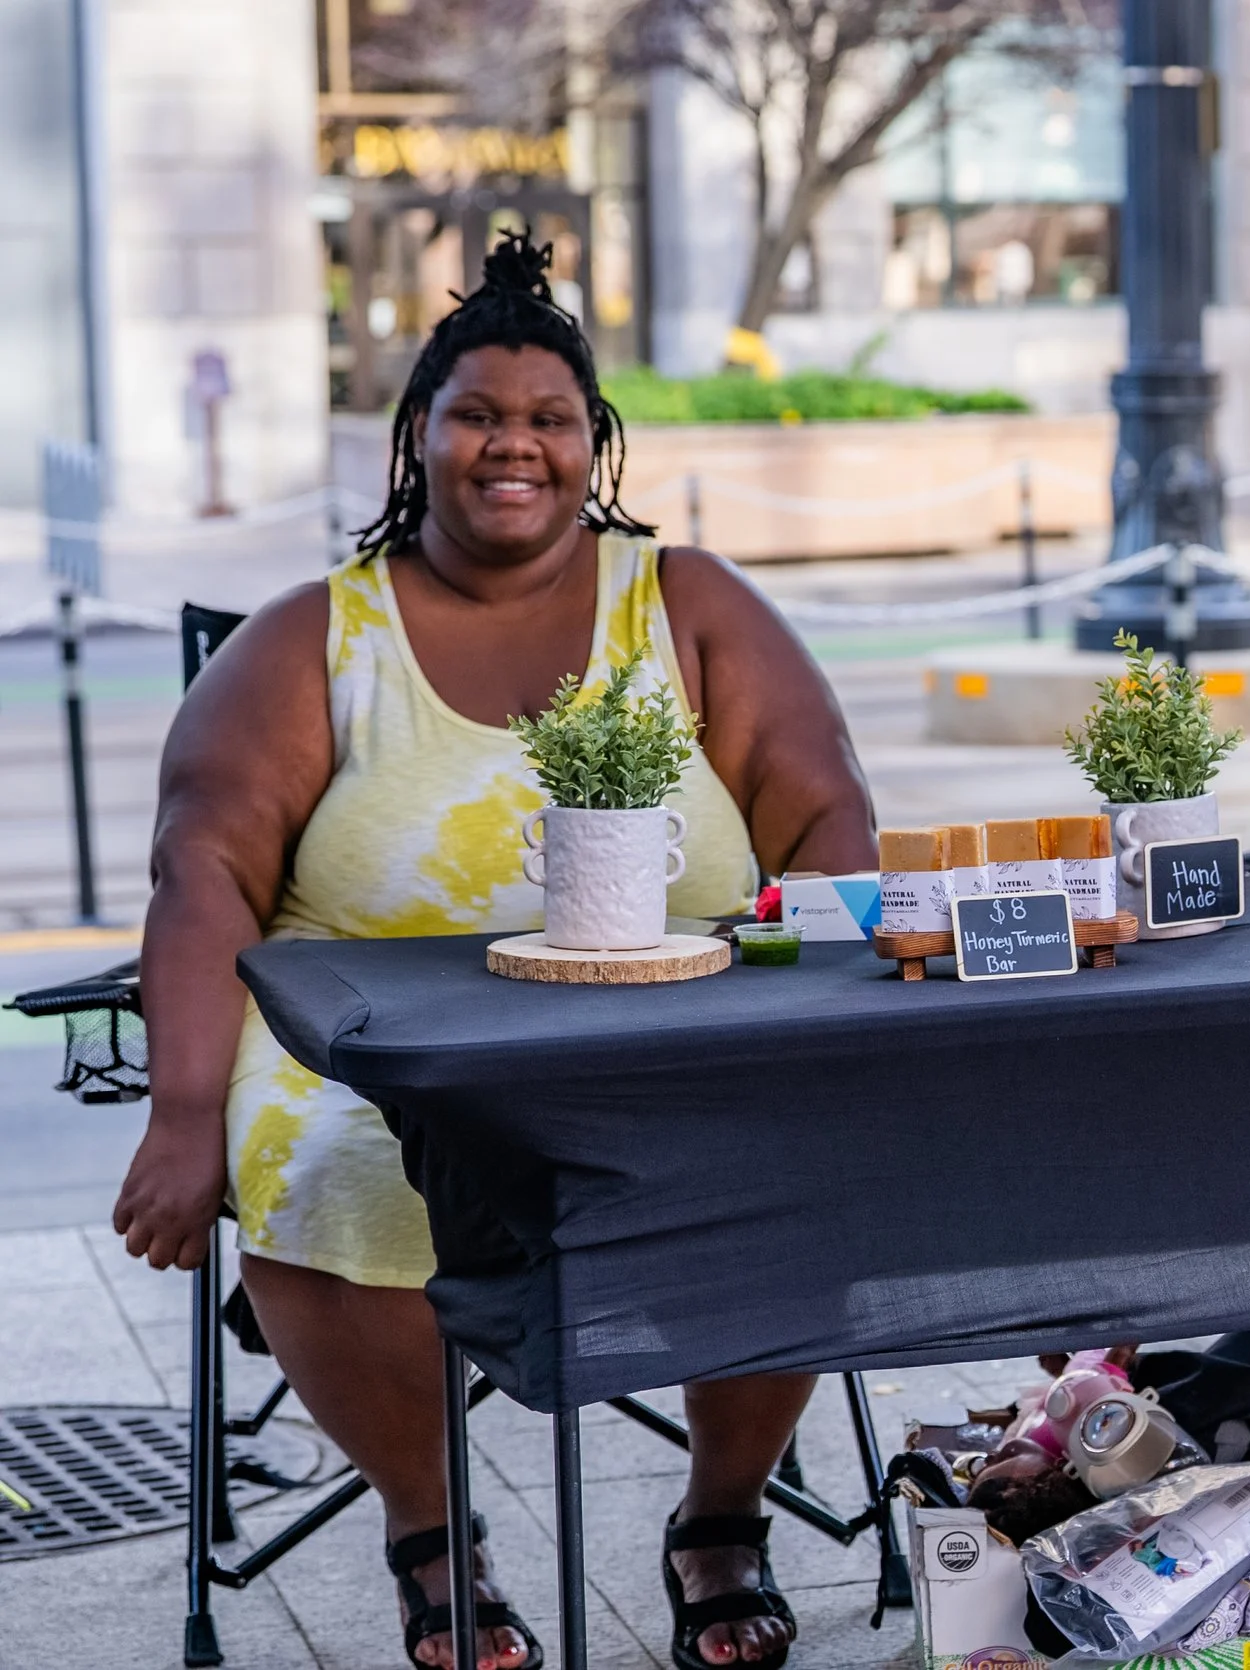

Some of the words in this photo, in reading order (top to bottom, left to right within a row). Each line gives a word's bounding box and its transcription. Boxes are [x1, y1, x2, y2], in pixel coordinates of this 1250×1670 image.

[1172, 859, 1221, 889] Hand
[997, 880, 1031, 888] NATURAL
[1064, 878, 1097, 886] NATURAL
[1167, 887, 1216, 914] Made
[800, 907, 839, 916] vistaprint
[989, 897, 1027, 925] $8
[964, 931, 1014, 955] Honey
[1011, 929, 1069, 947] Turmeric
[986, 955, 1017, 973] Bar
[946, 1541, 970, 1551] USDA
[943, 1553, 974, 1561] ORGANIC
